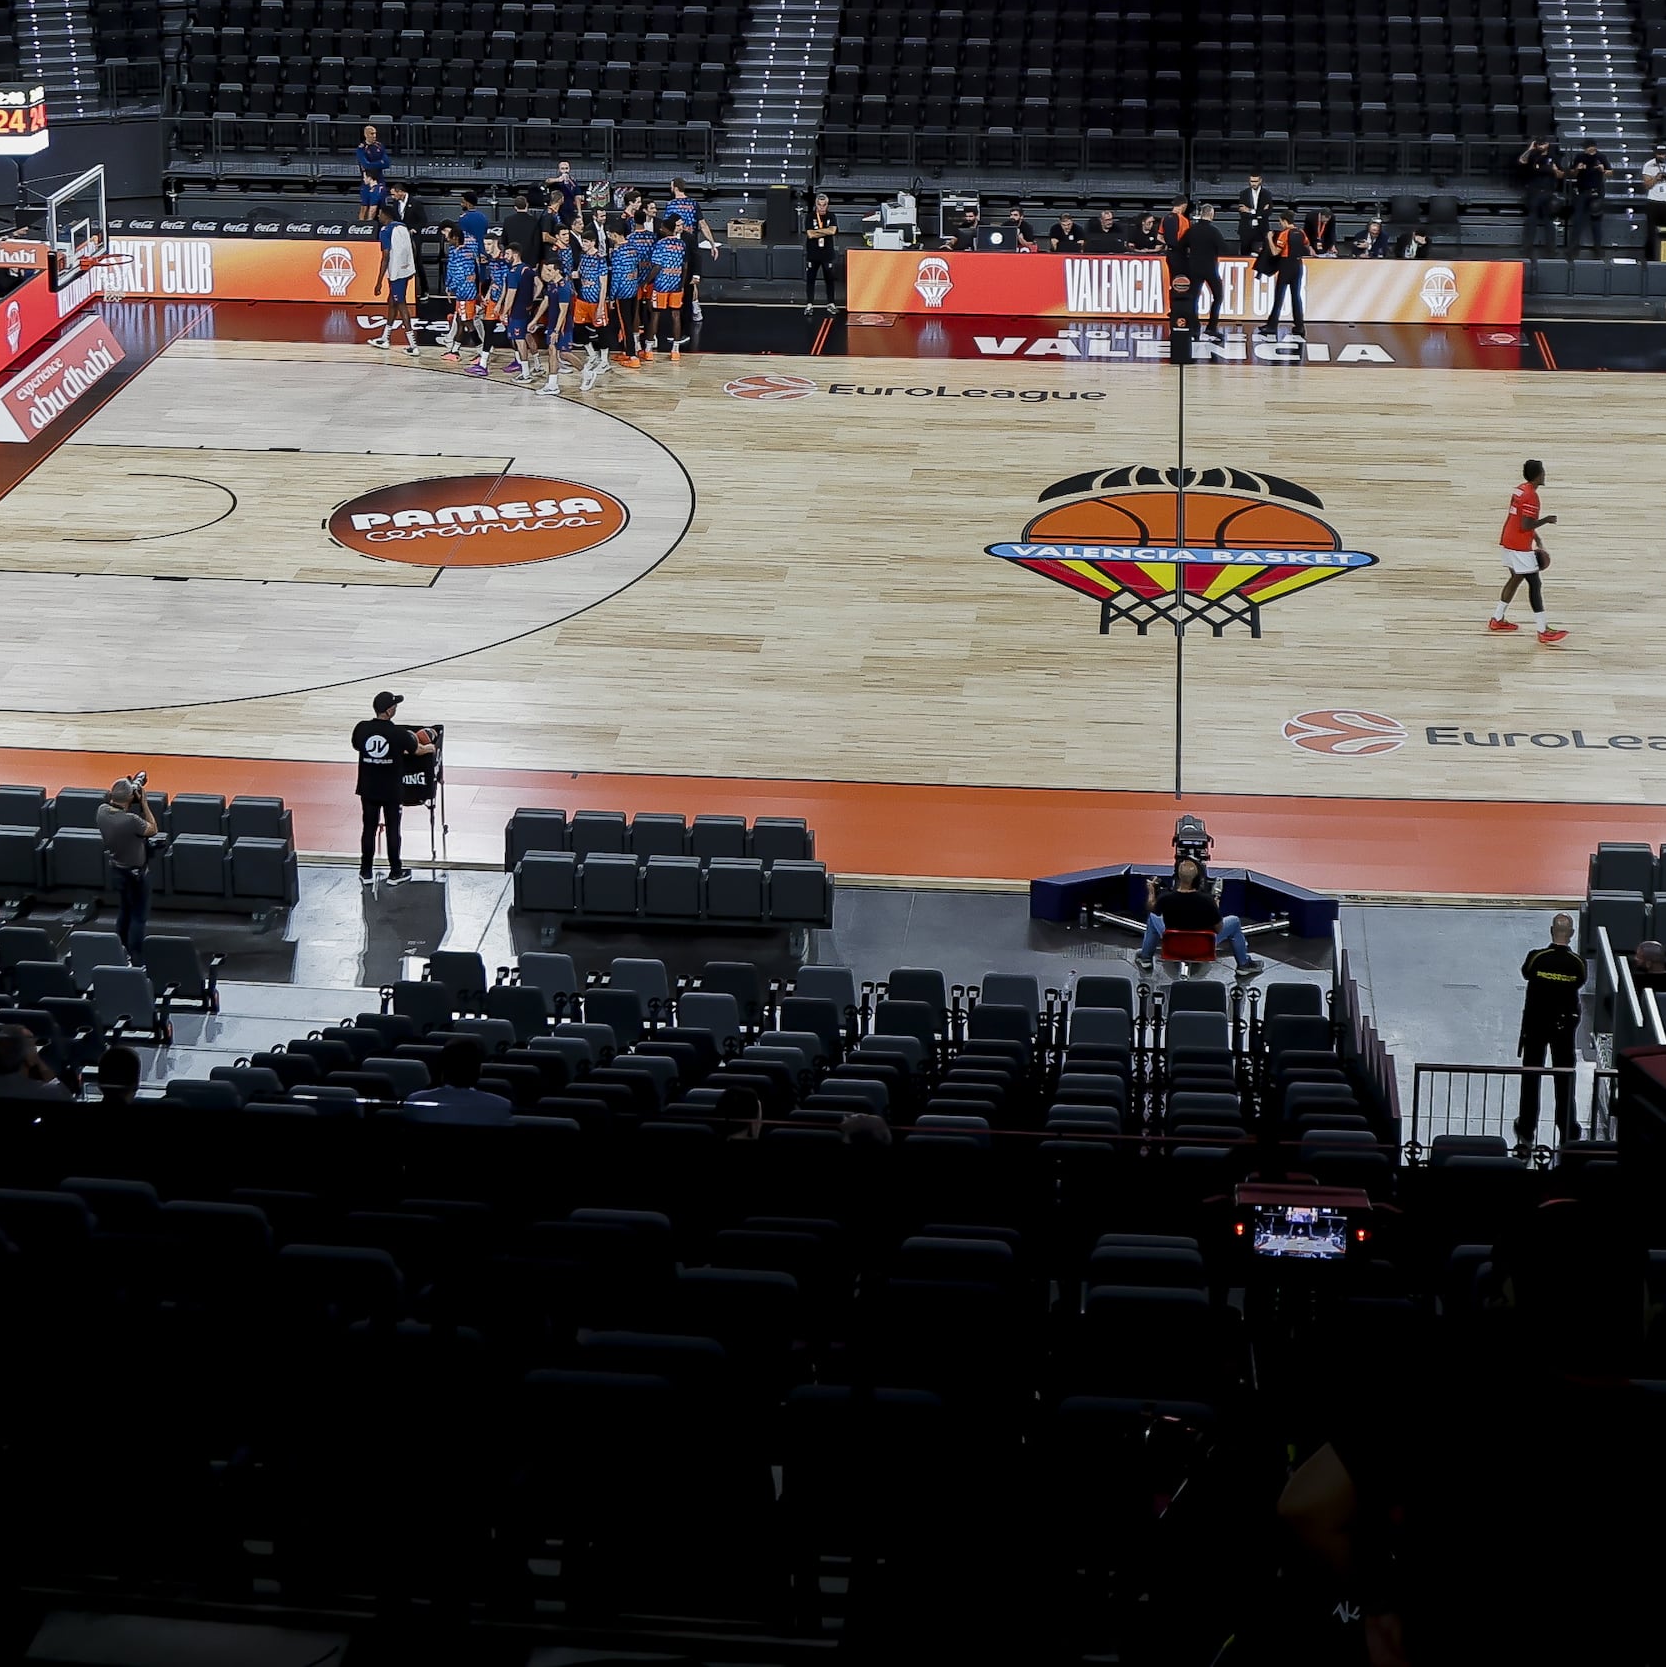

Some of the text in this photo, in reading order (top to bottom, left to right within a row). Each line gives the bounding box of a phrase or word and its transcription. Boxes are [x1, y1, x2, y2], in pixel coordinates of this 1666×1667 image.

[161, 241, 214, 294] CLUB
[1065, 258, 1164, 313] VALENCIA
[974, 336, 1396, 363] VALENCIA
[1057, 329, 1154, 340] ROIG
[16, 357, 64, 401] experience
[828, 383, 1107, 403] EuroLeague
[28, 389, 67, 430] abu
[350, 496, 604, 532] PAMESA
[364, 512, 602, 544] cerámica
[1010, 543, 1354, 566] VALENCIA BASKET
